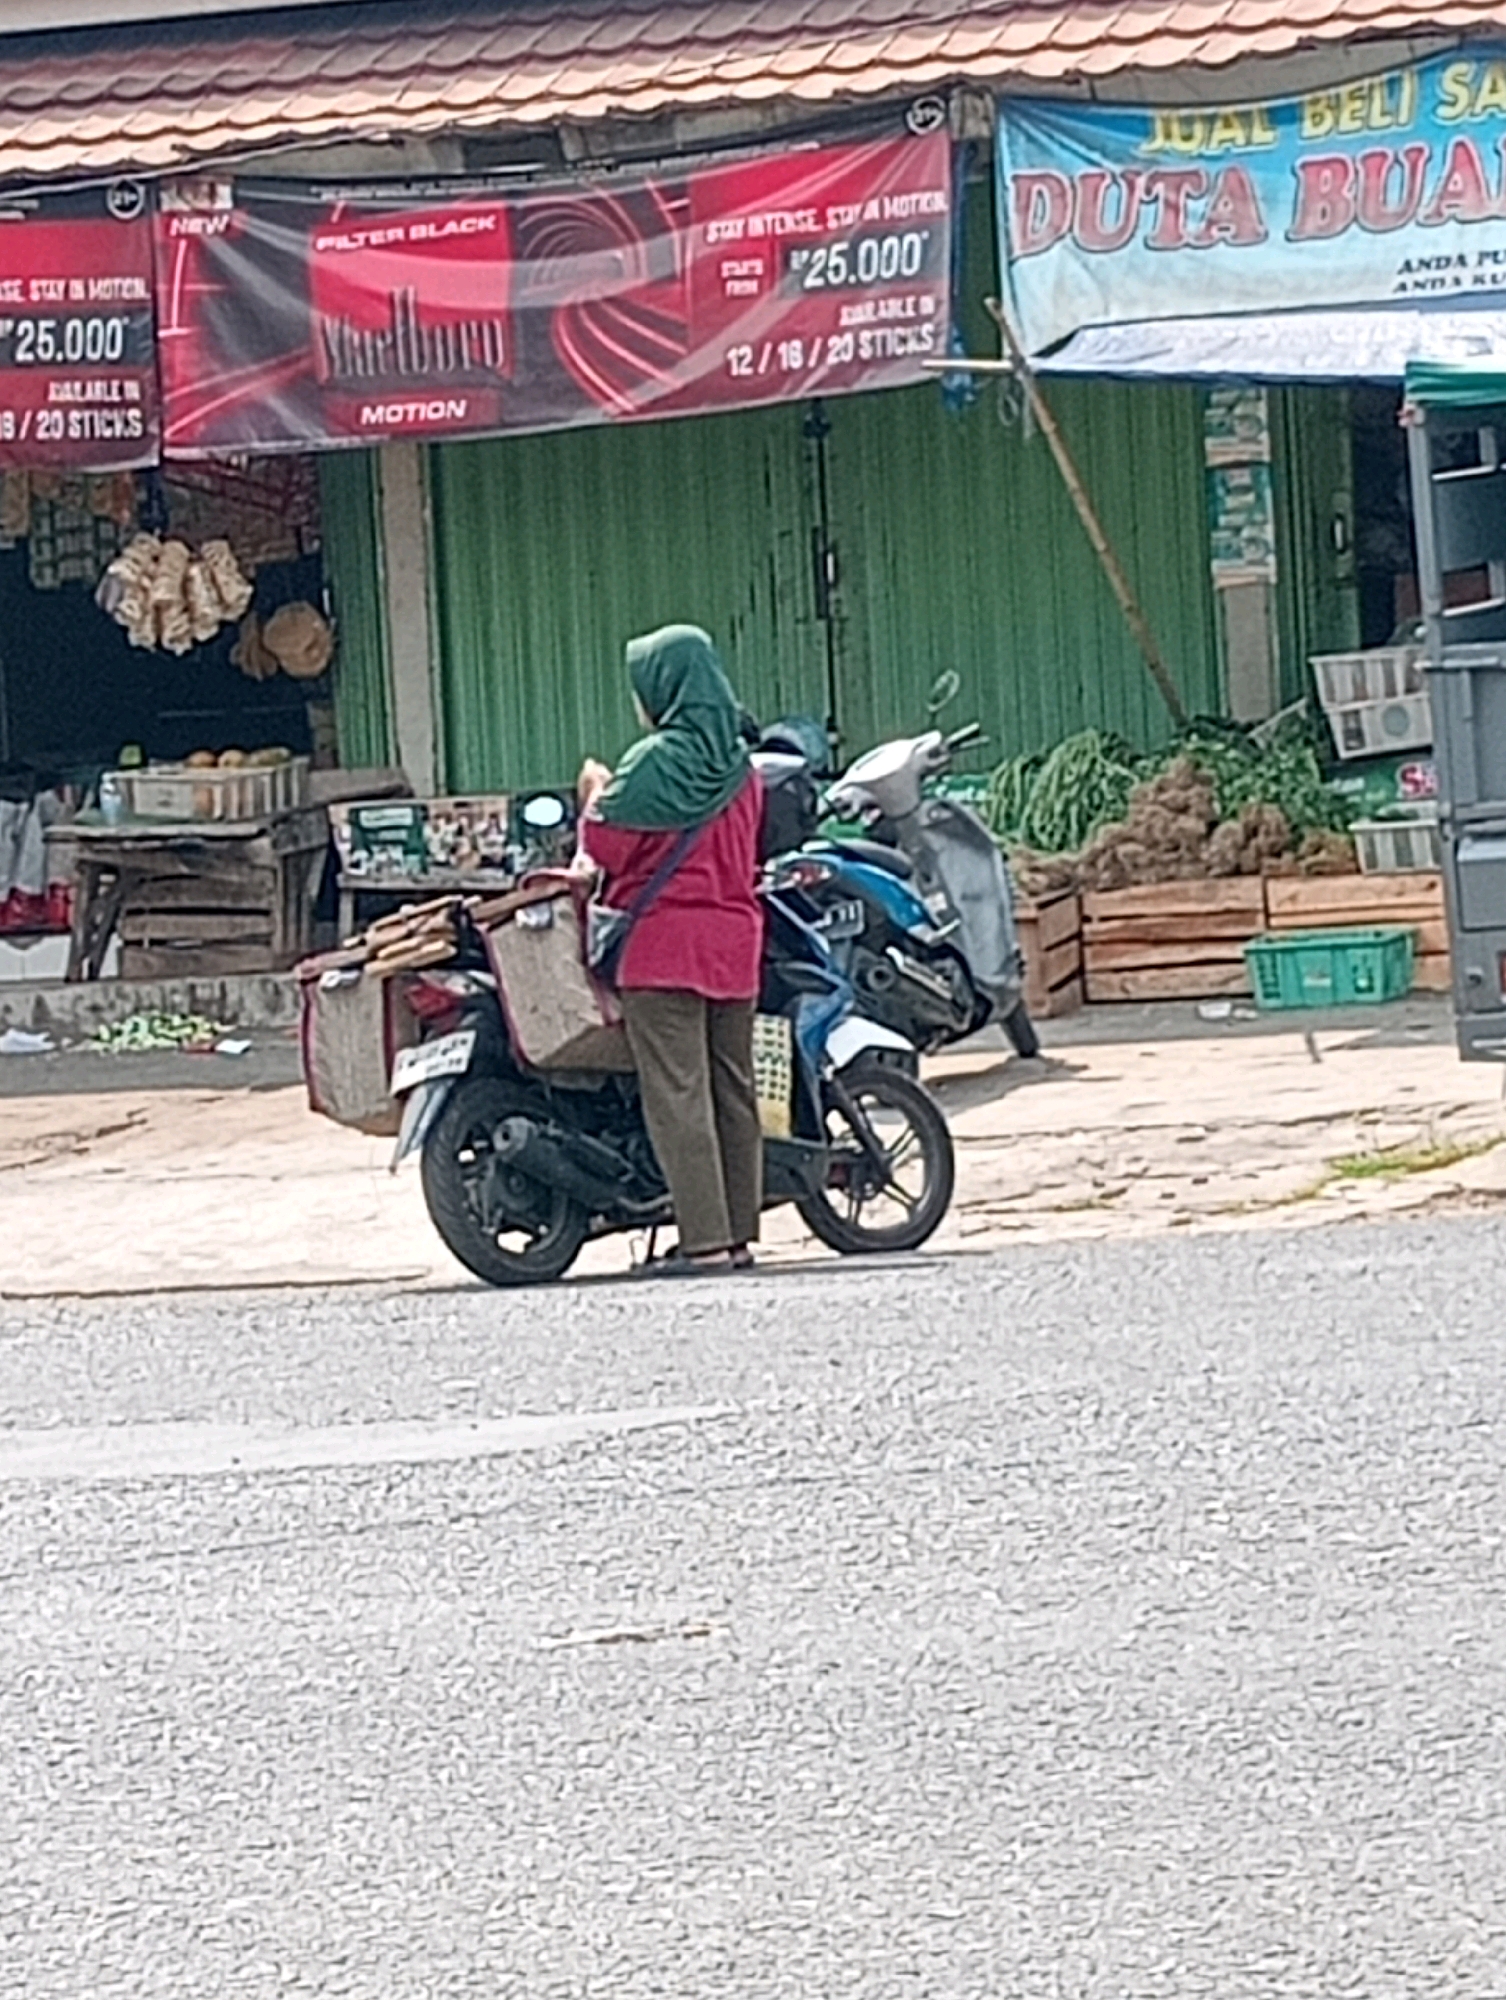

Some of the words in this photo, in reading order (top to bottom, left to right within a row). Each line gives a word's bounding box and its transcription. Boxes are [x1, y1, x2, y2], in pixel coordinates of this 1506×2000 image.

[1141, 108, 1276, 152] JUAL
[1300, 69, 1415, 139] BELI
[1009, 166, 1267, 259] DUTA
[1286, 136, 1506, 241] BUA
[170, 214, 229, 236] NEW
[316, 226, 405, 250] FILTER
[409, 215, 498, 240] BLACK
[706, 218, 743, 243] STAY
[826, 203, 860, 229] STAY
[1397, 253, 1468, 275] ANDA
[29, 278, 66, 301] STAY
[1392, 275, 1462, 293] ANDA
[839, 297, 916, 326] AVAILABLE
[726, 345, 754, 376] 12
[757, 342, 772, 374] /
[808, 336, 823, 368] /
[826, 332, 854, 366] 20
[858, 323, 935, 360] STICKS
[48, 379, 122, 402] AVAILABLE
[18, 409, 33, 441] /
[35, 408, 65, 440] 20
[68, 408, 143, 439] STICKS
[360, 399, 467, 425] MOTION
